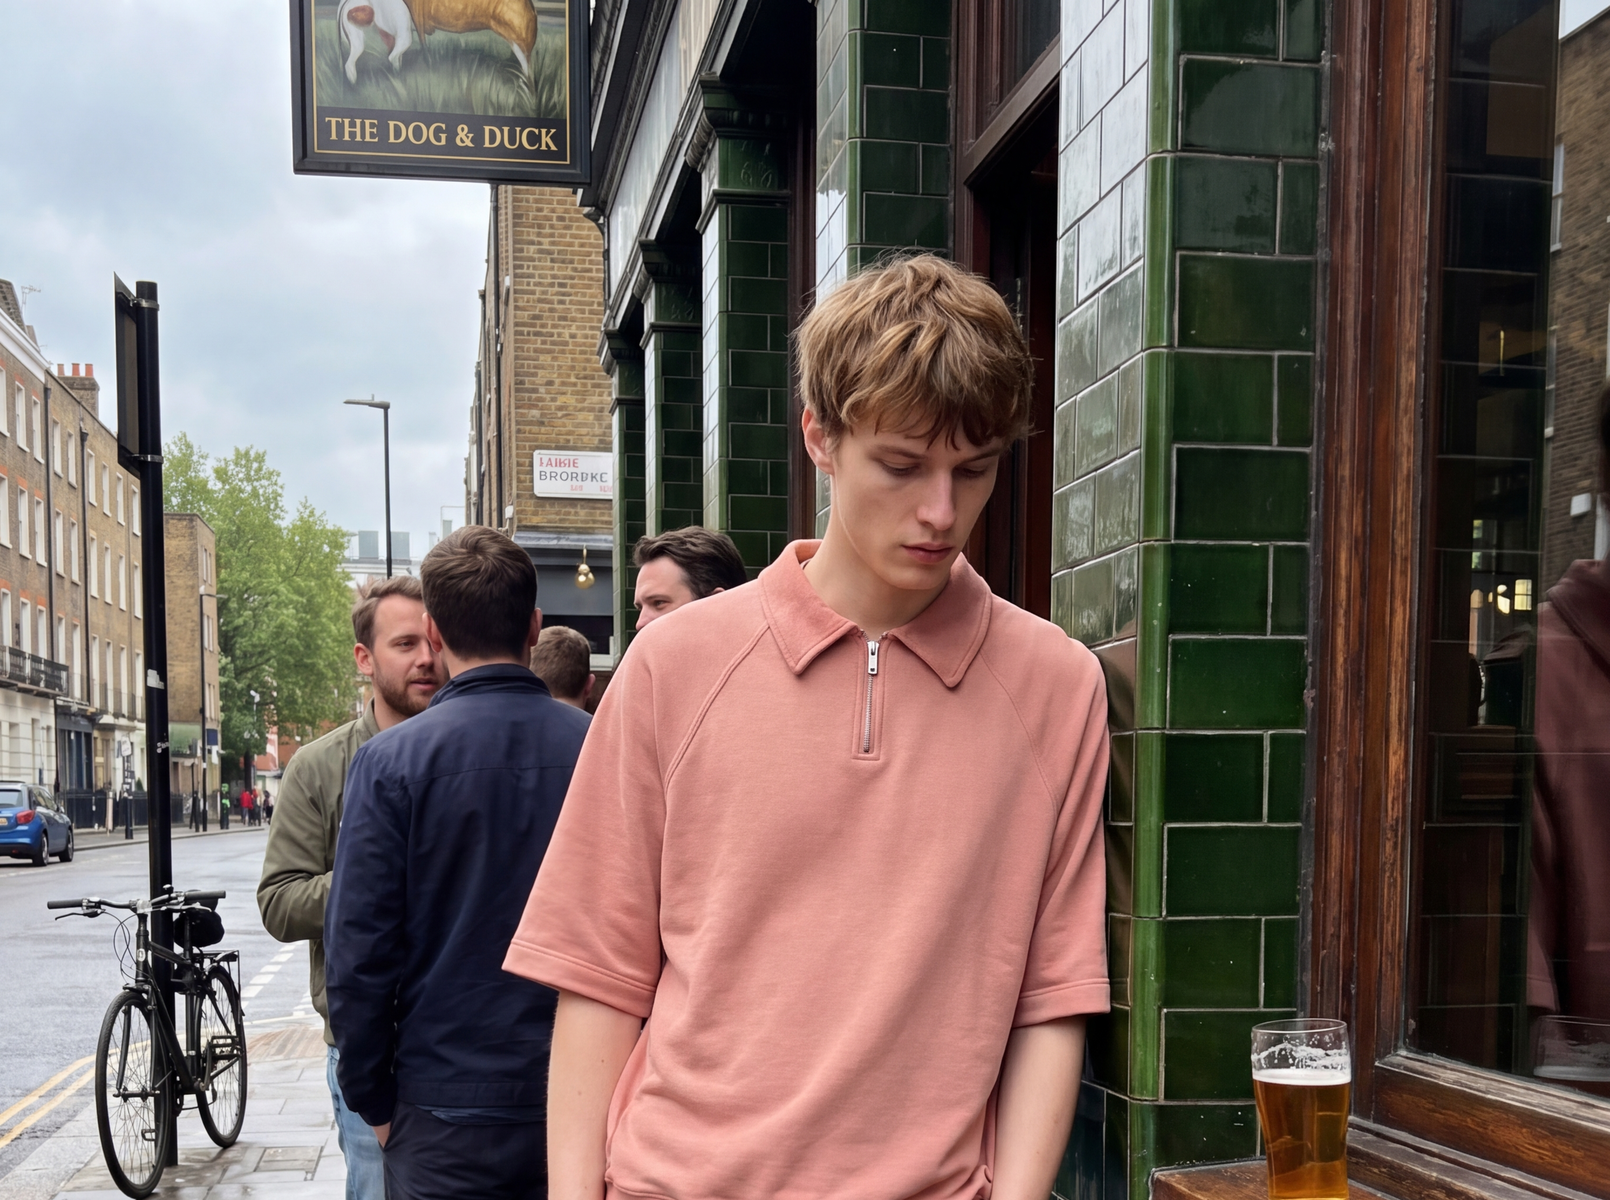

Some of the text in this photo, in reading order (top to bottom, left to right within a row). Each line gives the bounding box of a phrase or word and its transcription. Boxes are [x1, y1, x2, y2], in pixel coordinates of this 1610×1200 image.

[325, 117, 558, 151] THE DOG & DUCK
